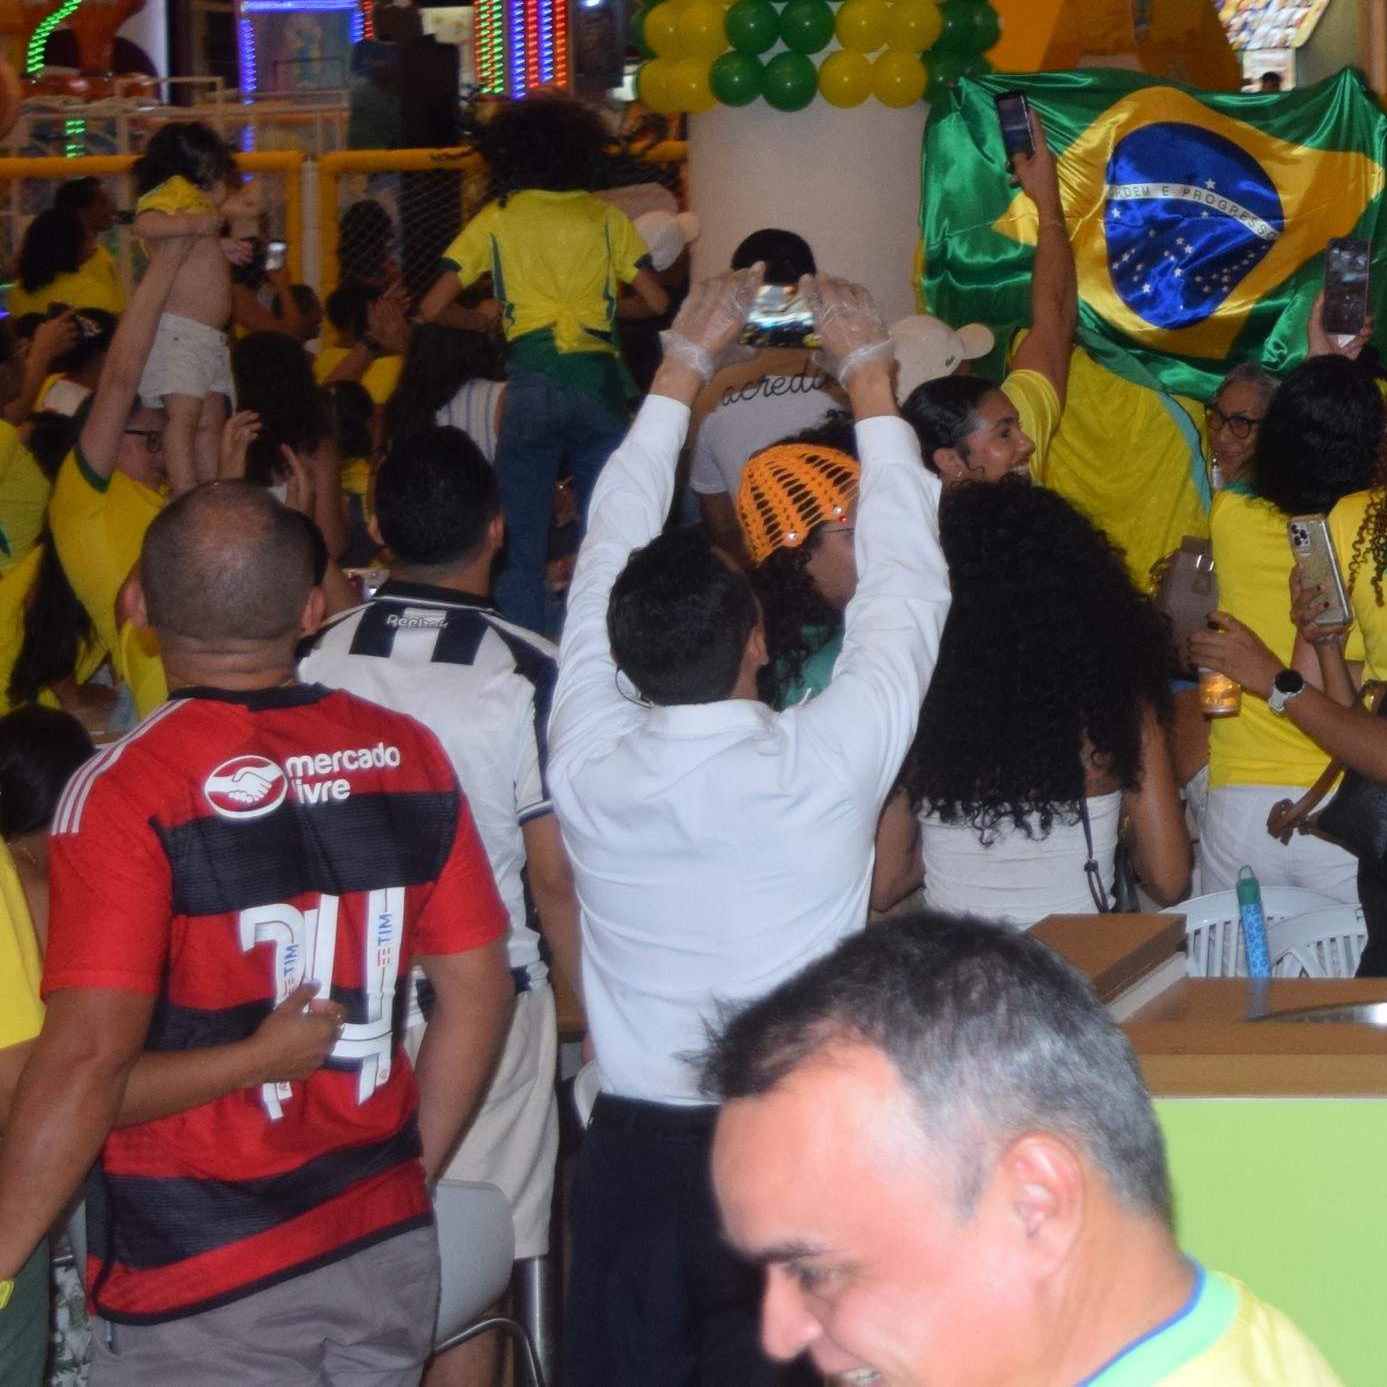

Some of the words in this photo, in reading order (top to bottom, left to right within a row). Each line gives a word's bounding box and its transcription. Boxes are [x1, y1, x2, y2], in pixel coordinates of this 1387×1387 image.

[1161, 185, 1169, 197] E
[386, 614, 449, 630] Reebok
[285, 741, 401, 777] mercado
[378, 912, 392, 947] TIM
[284, 943, 299, 977] TIM
